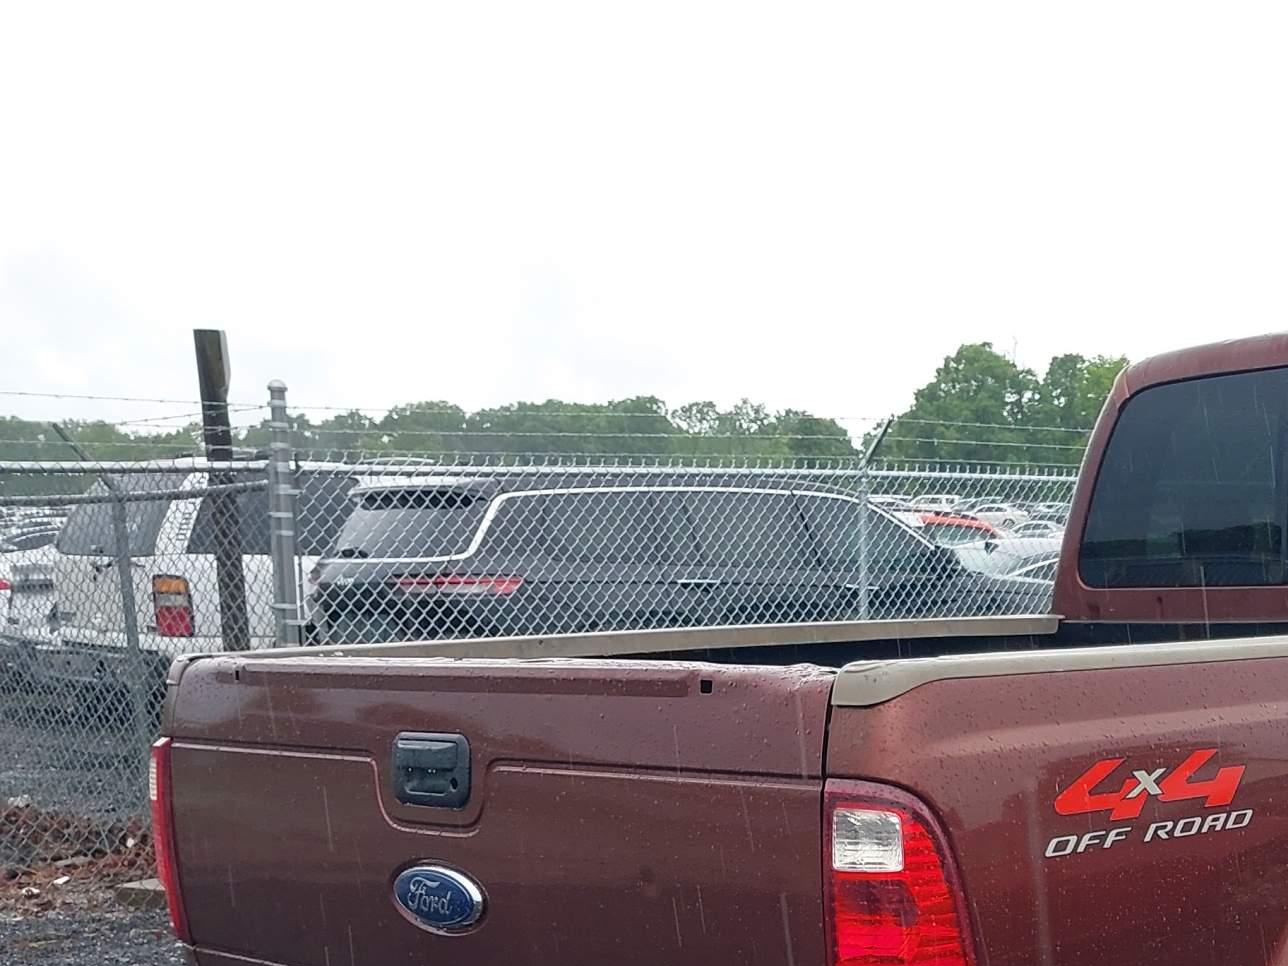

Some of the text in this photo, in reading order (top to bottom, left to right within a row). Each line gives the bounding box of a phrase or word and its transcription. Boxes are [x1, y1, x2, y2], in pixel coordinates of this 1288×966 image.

[1044, 808, 1254, 859] OFF ROAD
[406, 876, 454, 915] Ford
